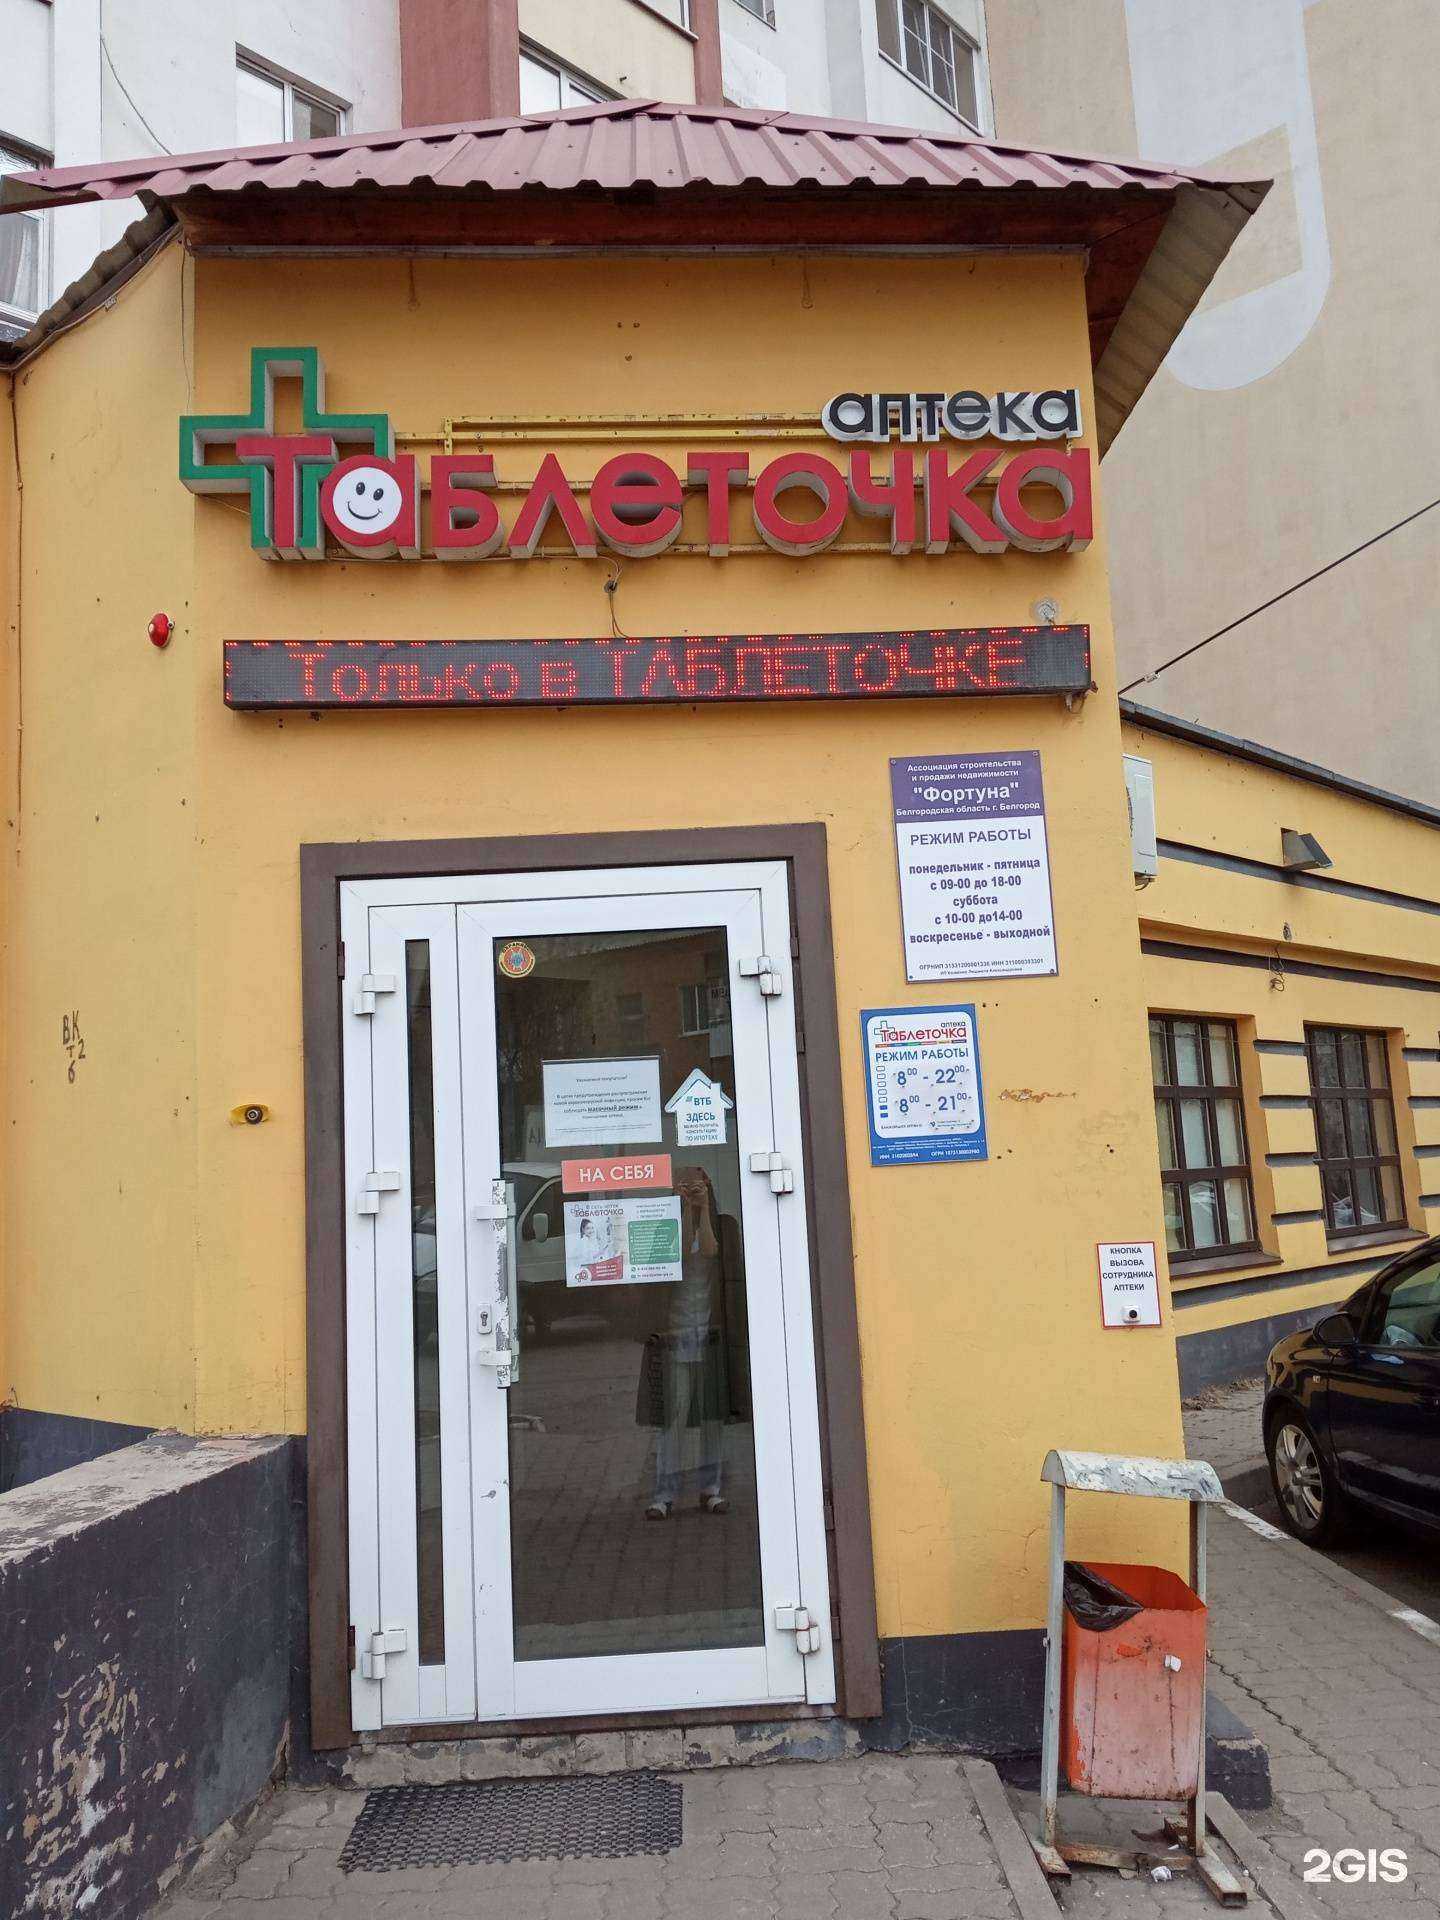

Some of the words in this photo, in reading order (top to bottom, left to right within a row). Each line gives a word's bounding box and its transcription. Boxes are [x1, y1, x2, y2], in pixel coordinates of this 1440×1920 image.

[824, 388, 1083, 441] аптека
[907, 762, 958, 772] Ассоциация
[960, 760, 1021, 770] строительства
[920, 773, 956, 782] продажи
[957, 770, 1019, 780] недвижимости
[913, 782, 1019, 804] "Фортуна"
[896, 806, 955, 816] Белгородская
[956, 804, 990, 813] область
[1000, 802, 1040, 811] Белгород
[910, 832, 964, 846] РЕЖИМ
[968, 828, 1031, 843] РАБОТЫ
[909, 861, 985, 875] понедельник
[994, 859, 1041, 870] пятница
[930, 882, 937, 890] с
[940, 878, 971, 889] 09-00
[974, 880, 988, 890] до
[991, 875, 1022, 887] 18-00
[952, 895, 998, 908] суббота
[934, 916, 942, 925] с
[945, 912, 975, 924] 10-00
[909, 930, 983, 944] воскресенье
[993, 925, 1050, 940] выходной
[875, 1050, 918, 1062] РЕЖИМ
[921, 1047, 969, 1060] РАБОТЫ
[694, 1097, 712, 1106] ВТБ
[686, 1112, 716, 1123] ЗДЕСЬ
[579, 1167, 605, 1183] НА
[610, 1163, 655, 1181] СЕБЯ
[1110, 1247, 1142, 1255] КНОПКА
[1109, 1259, 1145, 1267] ВЫЗОВА
[1102, 1271, 1154, 1280] СОТРУДНИКА
[1113, 1283, 1145, 1292] АПТЕКИ
